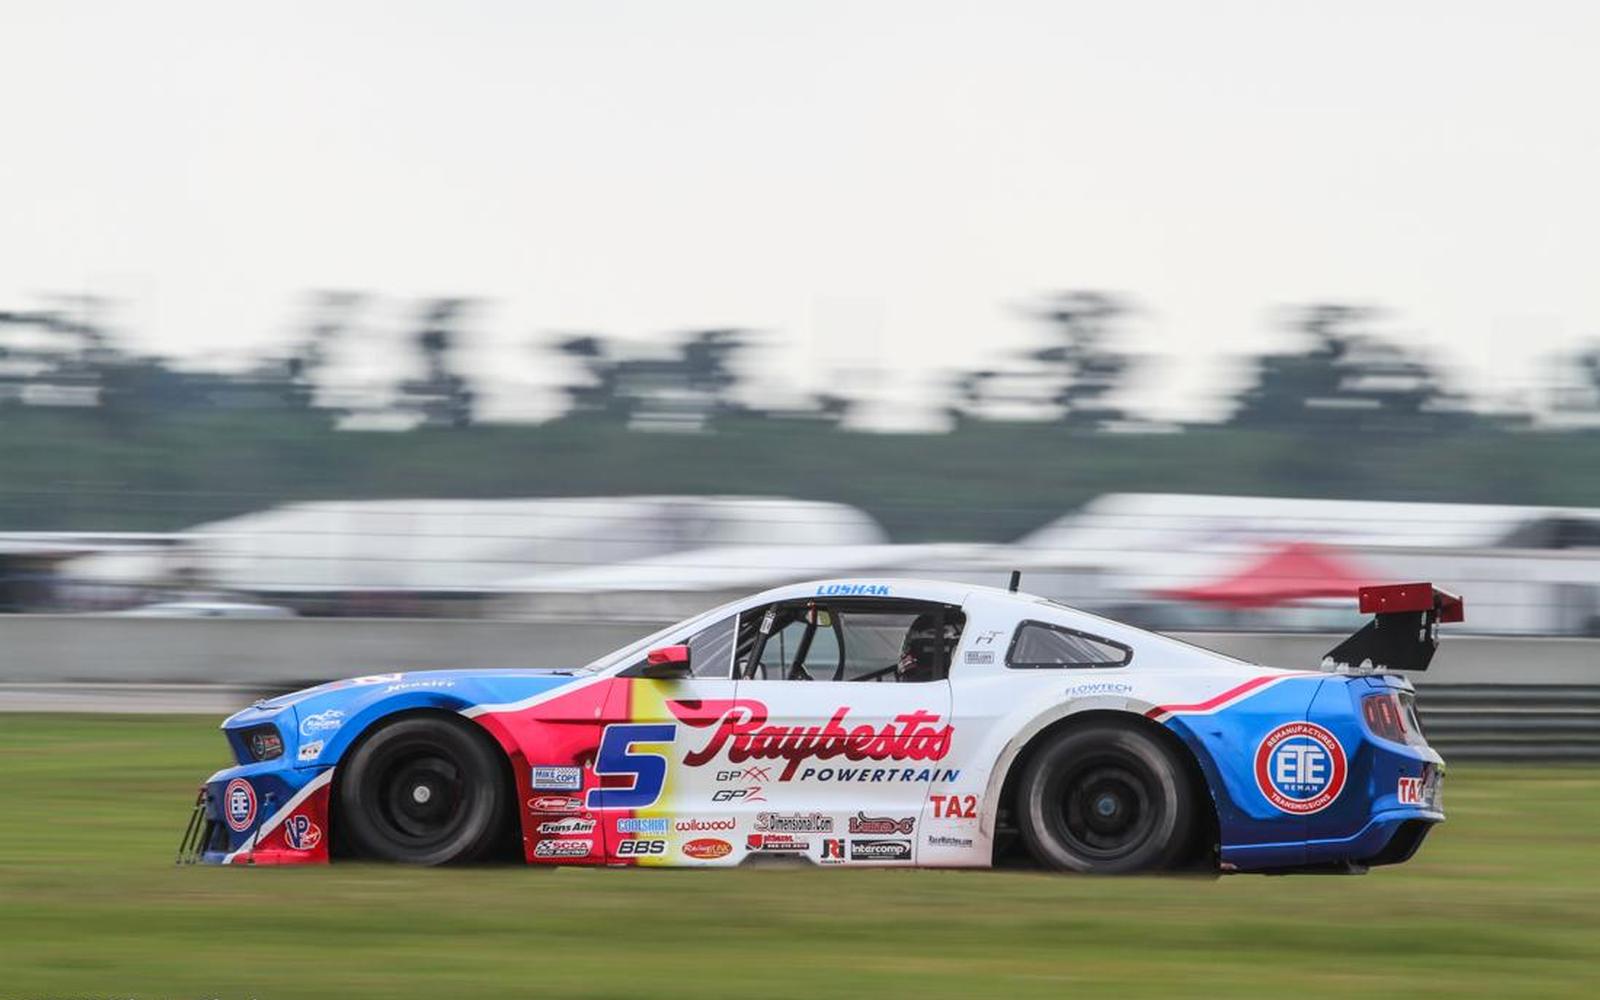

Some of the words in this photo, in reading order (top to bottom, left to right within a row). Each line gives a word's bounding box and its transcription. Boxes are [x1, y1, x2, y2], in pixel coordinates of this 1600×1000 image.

[816, 583, 890, 596] LOSHAK
[1065, 683, 1133, 696] FLOWTECH
[666, 699, 953, 782] Raybestos
[1266, 725, 1336, 750] REMANUFACTURED
[587, 724, 676, 810] 5
[1277, 745, 1325, 784] ETE
[556, 773, 577, 783] COPE
[801, 768, 960, 783] POWERTRAIN
[929, 795, 977, 818] TA2
[1271, 793, 1331, 811] TRANSMISSIONS
[541, 823, 571, 832] Trans
[572, 822, 592, 832] Am
[617, 818, 669, 832] COOLSHIRT
[676, 817, 736, 831] wilwood
[286, 816, 310, 849] VP
[619, 841, 665, 855] BBS
[852, 844, 904, 856] Intercomp
